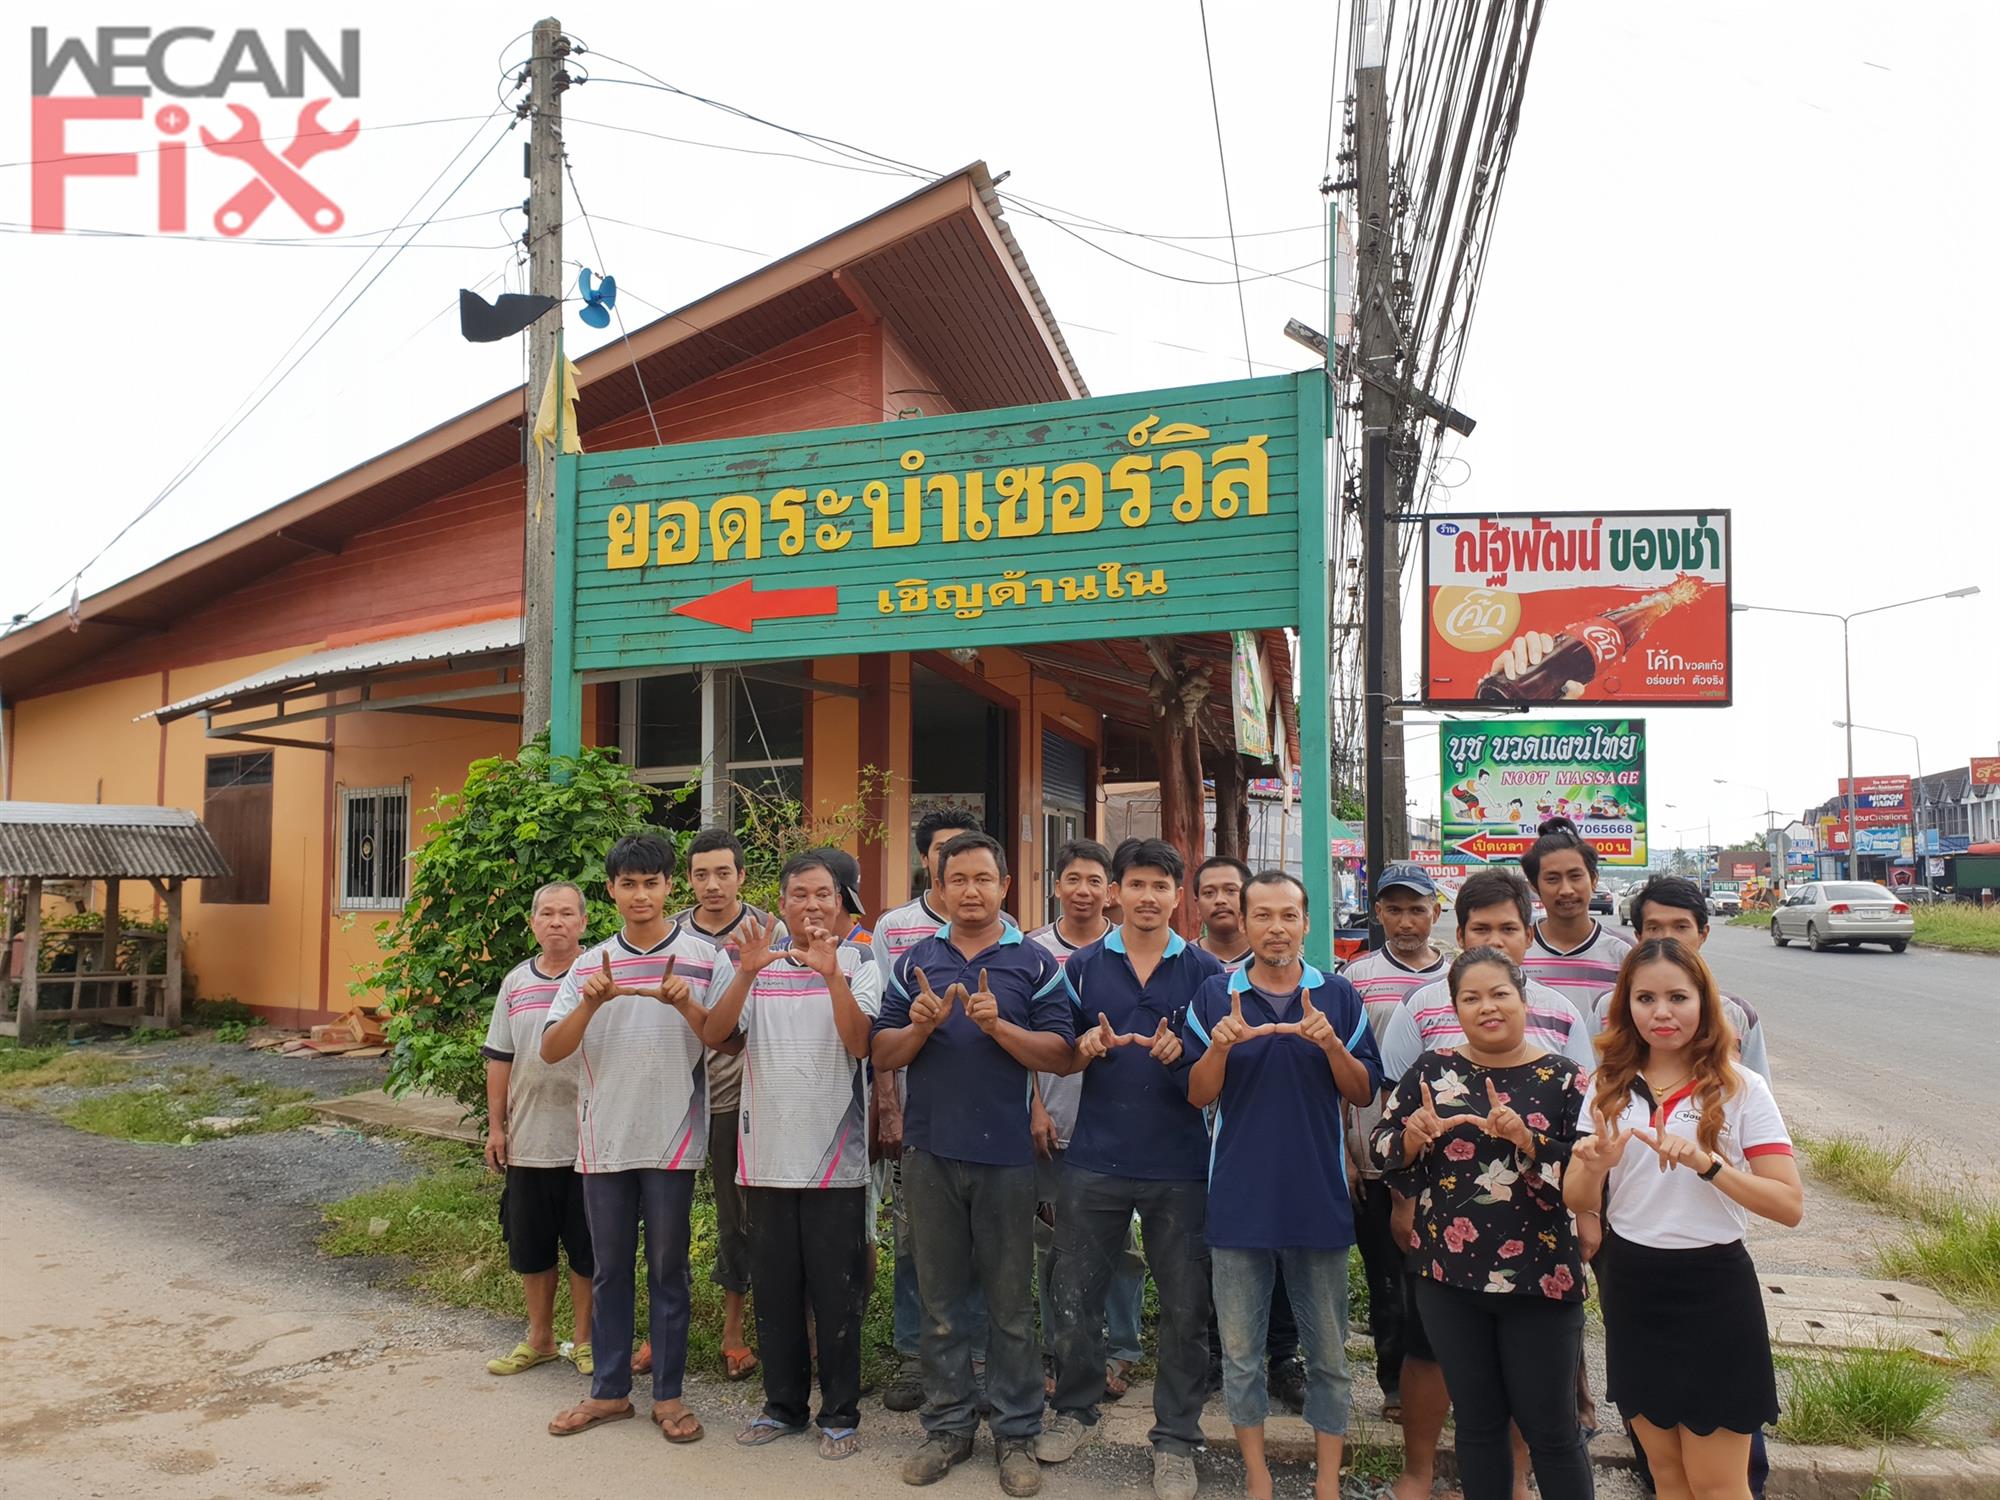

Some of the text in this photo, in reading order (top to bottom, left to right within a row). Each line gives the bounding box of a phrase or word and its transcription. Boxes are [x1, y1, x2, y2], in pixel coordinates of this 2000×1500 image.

[878, 562, 1168, 619] เชิญด้านใน
[1501, 771, 1640, 785] NOOT MASSAGE
[1577, 824, 1633, 834] 7065668
